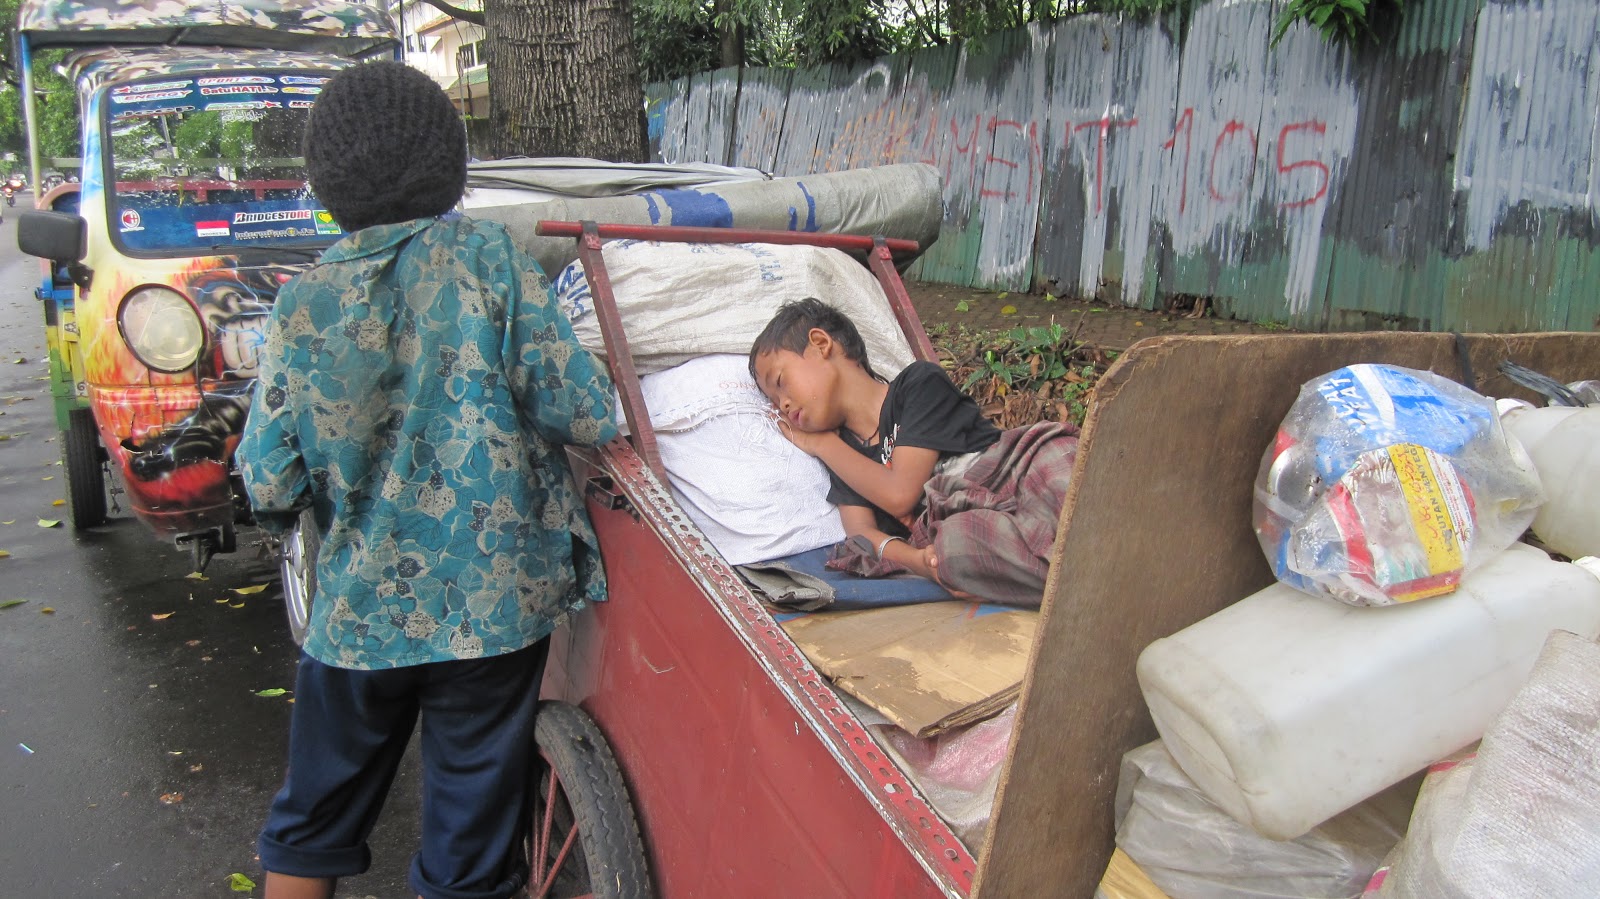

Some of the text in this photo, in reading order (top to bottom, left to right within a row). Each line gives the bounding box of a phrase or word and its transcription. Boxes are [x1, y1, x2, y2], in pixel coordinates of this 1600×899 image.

[124, 90, 188, 101] ENERGY
[1164, 107, 1329, 213] 105
[235, 210, 311, 223] BRIDGESTONE
